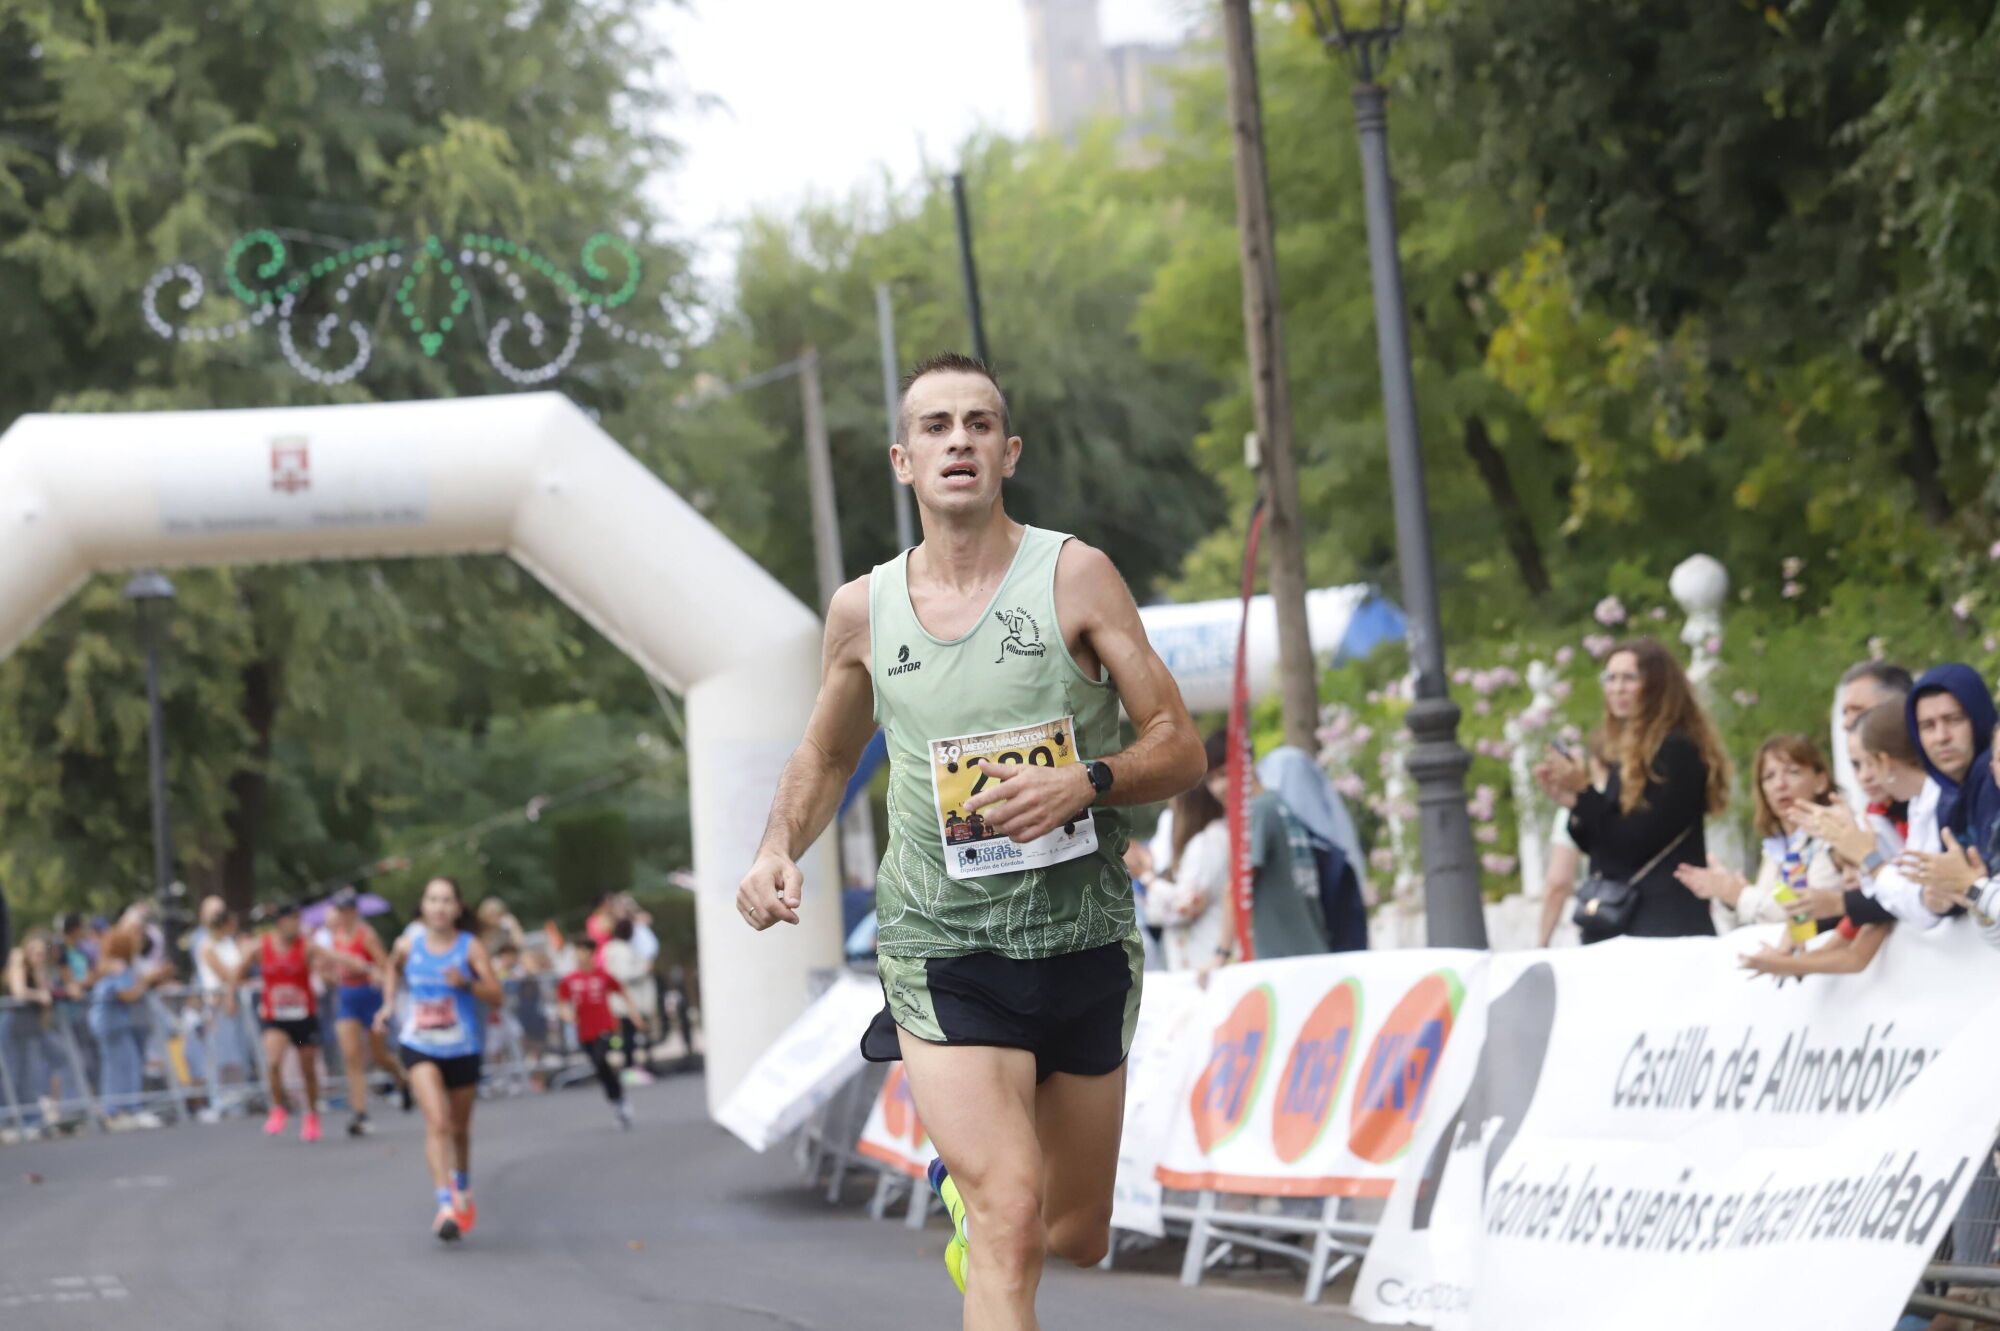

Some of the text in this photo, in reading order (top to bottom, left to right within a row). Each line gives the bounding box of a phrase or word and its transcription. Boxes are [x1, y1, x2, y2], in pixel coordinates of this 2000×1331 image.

[888, 661, 921, 677] VIATOR
[937, 745, 961, 765] 39
[962, 740, 993, 752] MEDIA
[1613, 1020, 1943, 1114] Castillo de Almodóva
[1558, 1163, 1614, 1245] los
[1797, 1149, 1971, 1247] realidad
